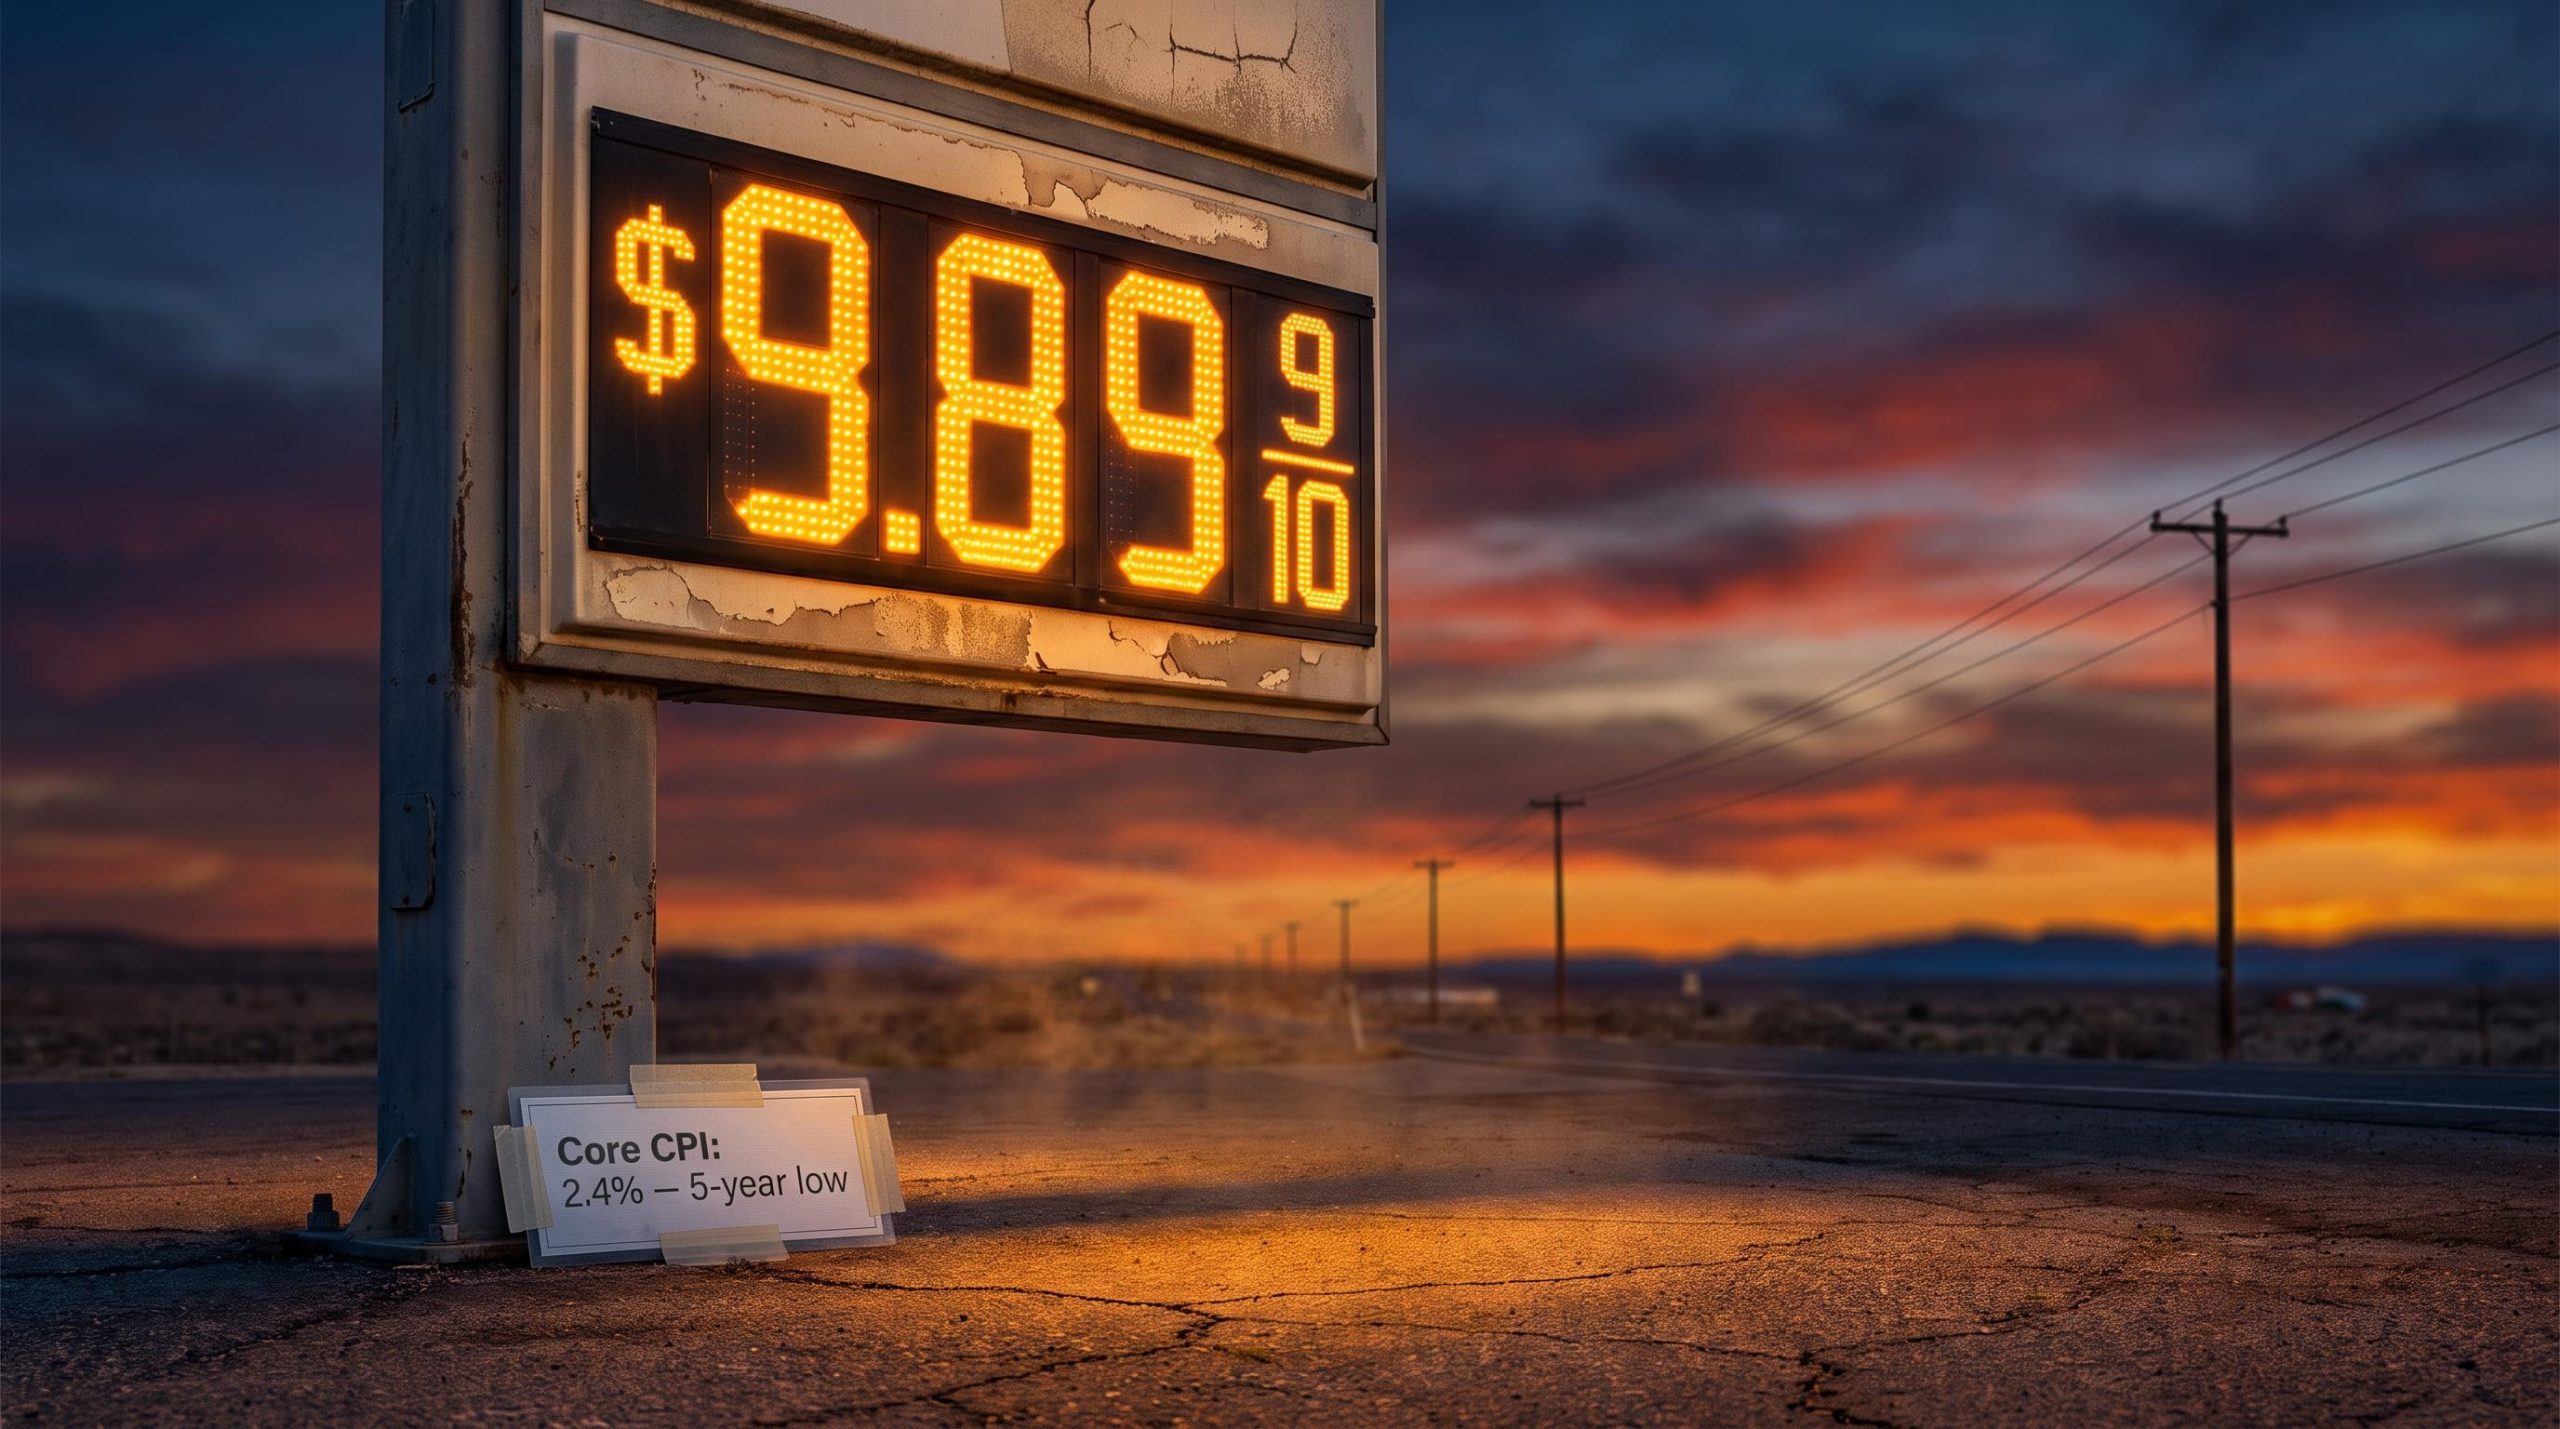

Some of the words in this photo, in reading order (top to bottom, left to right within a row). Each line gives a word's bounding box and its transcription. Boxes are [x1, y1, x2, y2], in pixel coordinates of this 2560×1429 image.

[1279, 312, 1336, 447] 9
[1262, 474, 1350, 611] 10
[557, 1136, 641, 1166] Core
[651, 1131, 721, 1162] CPI:
[562, 1175, 644, 1208] 2.4%
[690, 1171, 787, 1206] 5-year
[796, 1165, 849, 1195] low
